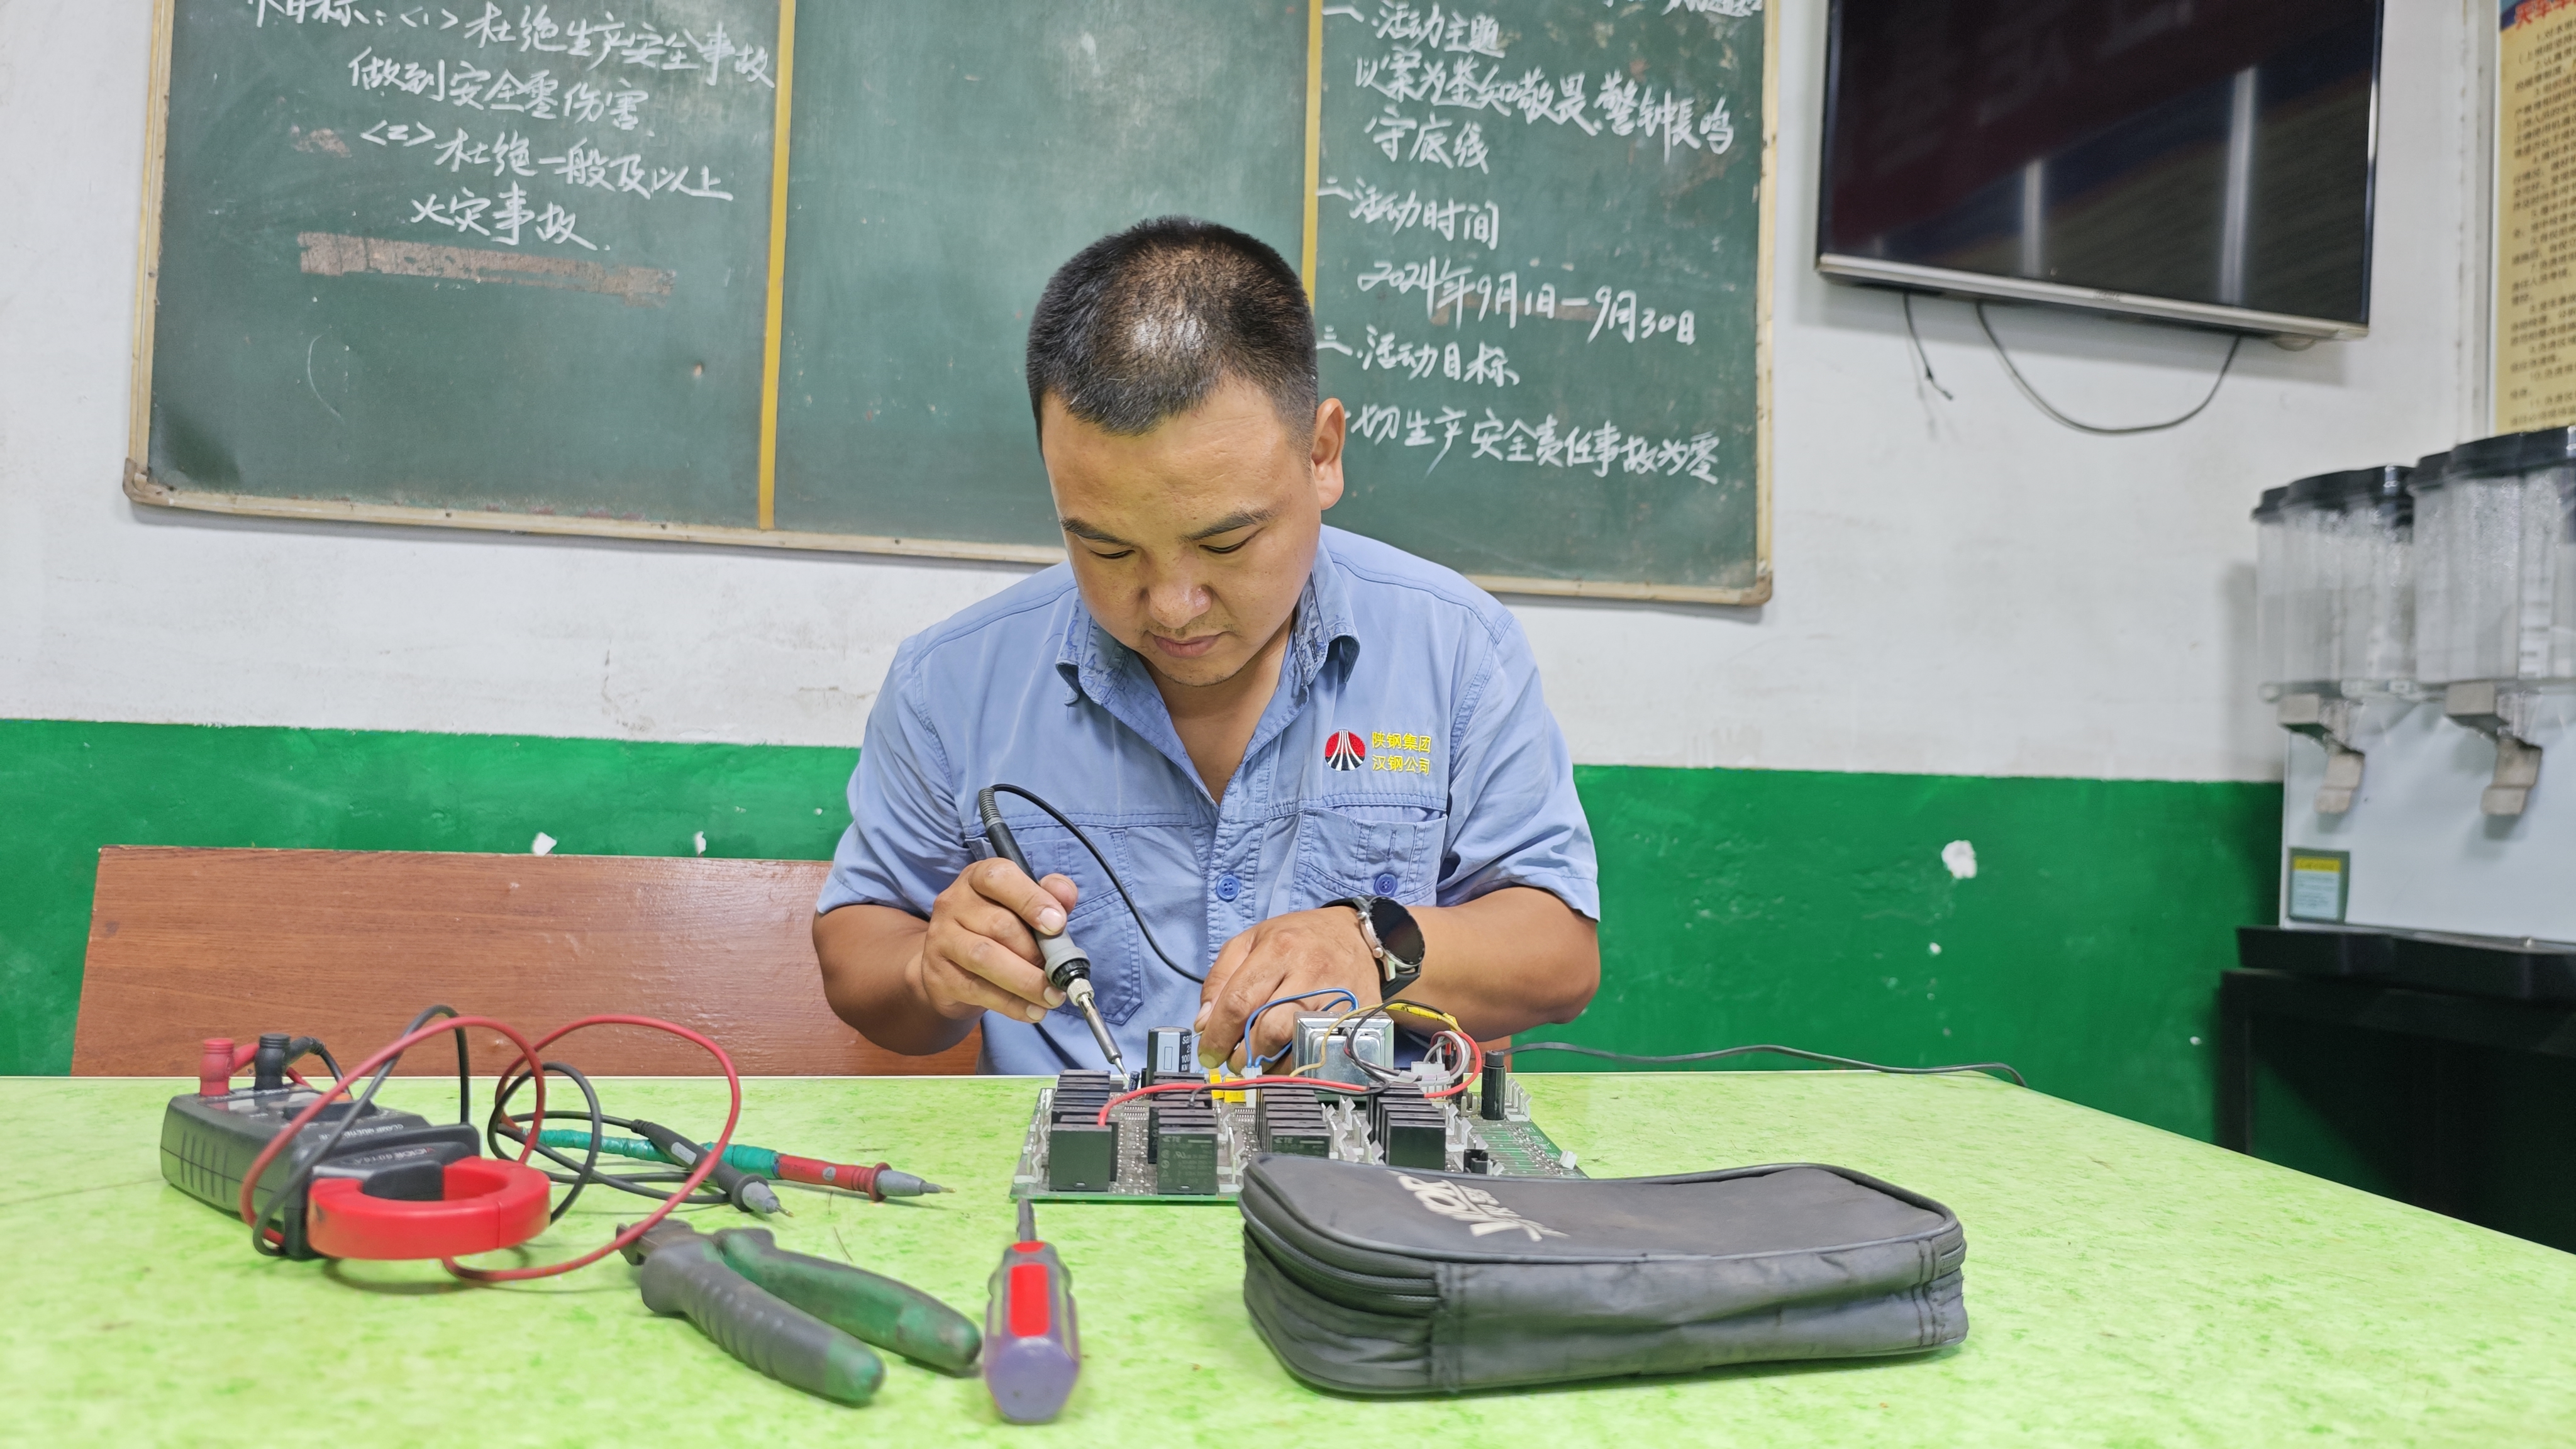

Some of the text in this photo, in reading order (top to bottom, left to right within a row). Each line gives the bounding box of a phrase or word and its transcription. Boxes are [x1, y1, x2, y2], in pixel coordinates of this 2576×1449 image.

[1363, 103, 1489, 175] 守底线
[1372, 731, 1431, 753] 陕钢集团
[1372, 754, 1430, 775] 汉钢公司
